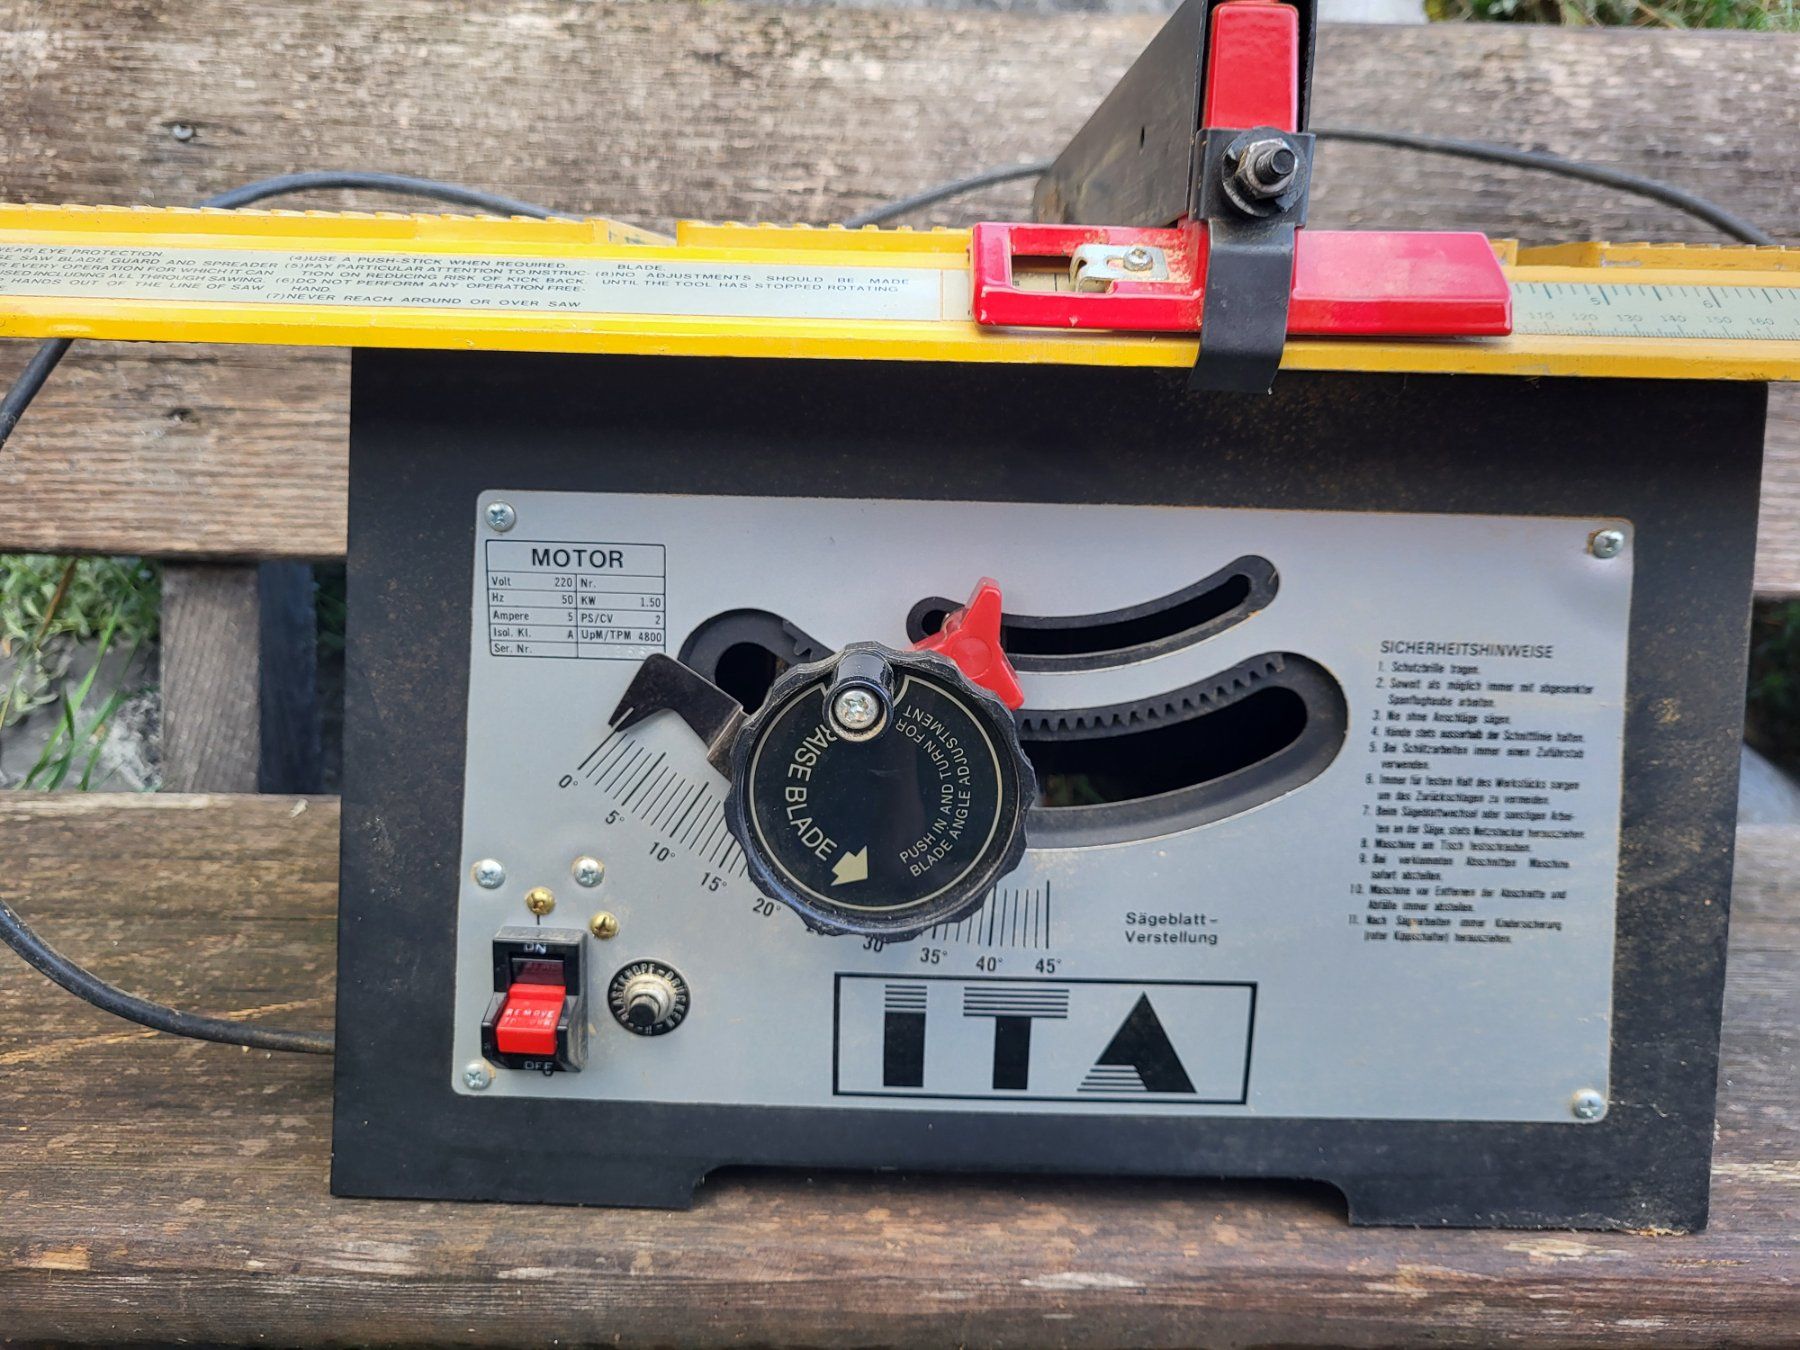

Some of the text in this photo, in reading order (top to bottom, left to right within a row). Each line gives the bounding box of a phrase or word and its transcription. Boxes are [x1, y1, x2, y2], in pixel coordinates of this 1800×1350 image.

[62, 263, 144, 271] OPERATION
[203, 260, 279, 268] SPREADER
[358, 257, 442, 265] PUSH-STICK
[33, 270, 105, 278] INCLUDING
[336, 264, 424, 272] PARTICULAR
[426, 266, 503, 274] ATTENTION
[366, 272, 437, 280] REDUCING
[646, 273, 752, 281] ADJUSTMENTS
[766, 275, 824, 283] SHOULD
[466, 283, 544, 291] OPERATION
[401, 296, 462, 304] AROUND
[548, 300, 582, 308] SAW
[1590, 297, 1714, 309] 5 6
[1616, 313, 1643, 322] 130
[1660, 314, 1687, 323] 140
[531, 548, 624, 568] MOTOR
[491, 576, 573, 588] Volt 220
[580, 578, 597, 589] Nr.
[492, 592, 574, 605] Hz 50
[581, 595, 662, 608] KW 1.50
[492, 610, 574, 623] Ampere 5
[581, 612, 661, 625] PS/CV 2
[493, 627, 514, 638] Isol.
[567, 630, 574, 640] A
[581, 630, 663, 643] UpM/TPM 4800
[494, 643, 533, 654] Ser. Nr.
[1379, 640, 1554, 658] SICHERHEITSHINWEISE
[558, 774, 579, 789] 0°
[895, 718, 954, 864] PUSH IN AND TURN FOR
[902, 704, 971, 877] BLADE ANGLE ADJUSTMENT
[604, 809, 625, 825] 5°
[785, 786, 838, 862] BLADE
[648, 841, 676, 862] 10°
[699, 871, 728, 892] 15°
[751, 897, 782, 918] 20°
[1125, 930, 1219, 946] Verstellung
[524, 943, 547, 954] ON
[919, 947, 949, 966] 35°
[975, 955, 1003, 972] 40°
[1035, 957, 1063, 975] 45°
[882, 984, 1197, 1093] ITA
[524, 1061, 554, 1070] OFF
